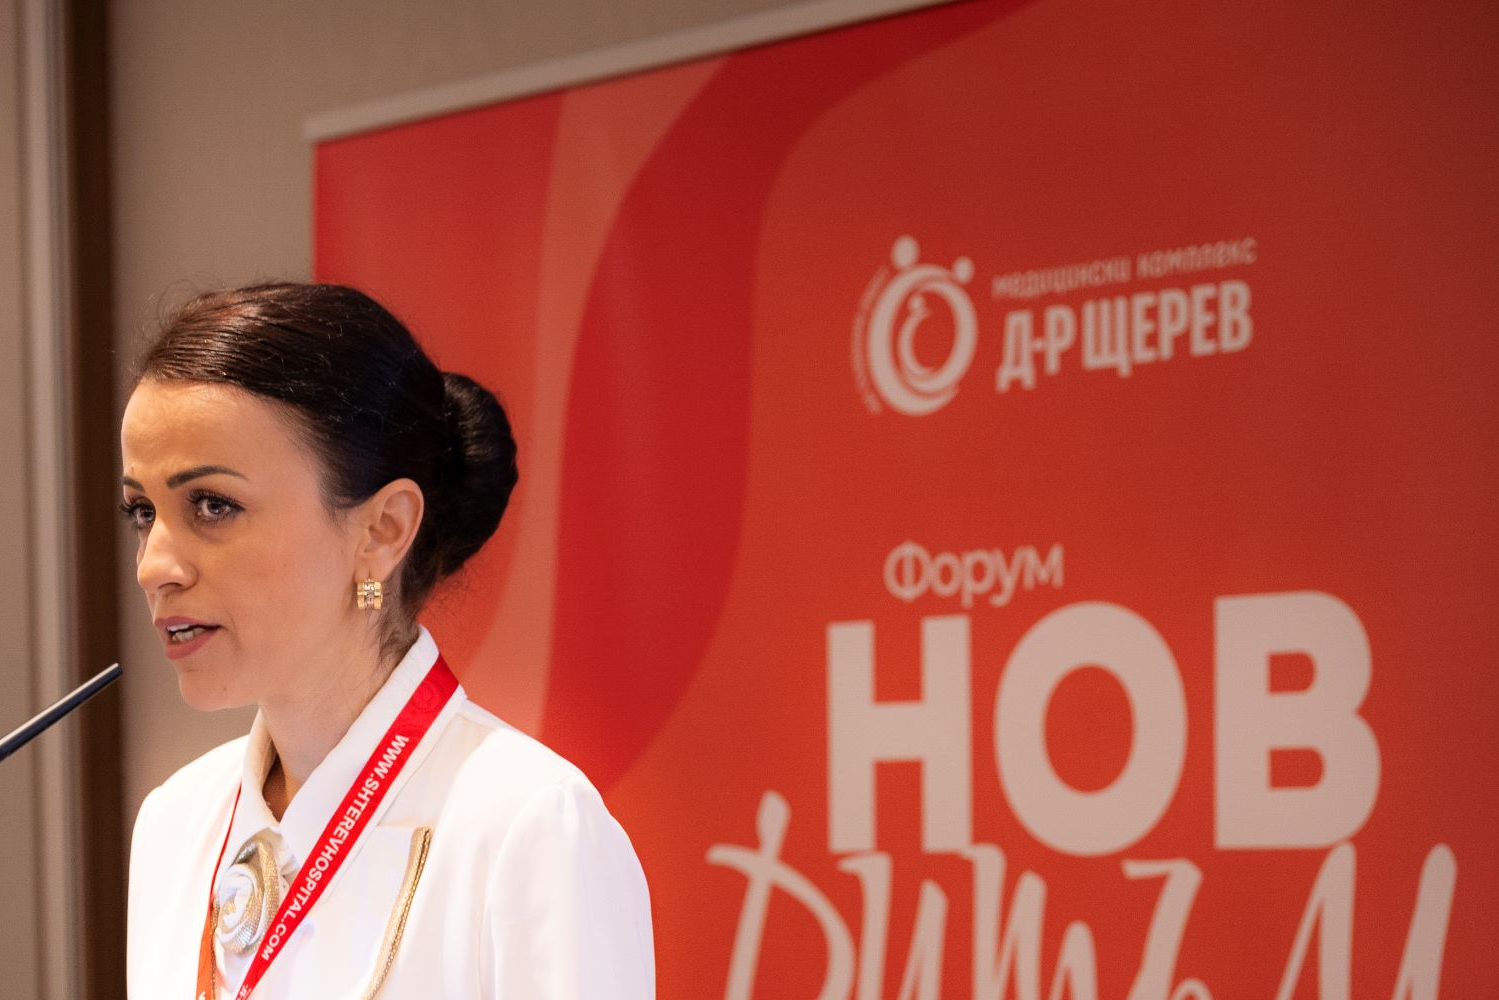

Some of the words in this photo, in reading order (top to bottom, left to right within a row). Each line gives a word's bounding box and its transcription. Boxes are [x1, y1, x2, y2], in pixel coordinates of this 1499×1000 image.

[996, 304, 1076, 392] Д-Р
[1082, 280, 1253, 377] ЩЕРЕВ
[884, 540, 1065, 607] Форум
[826, 590, 1382, 857] НОВ
[261, 733, 410, 962] WWW.SHTEREVHOSPITAL.COM
